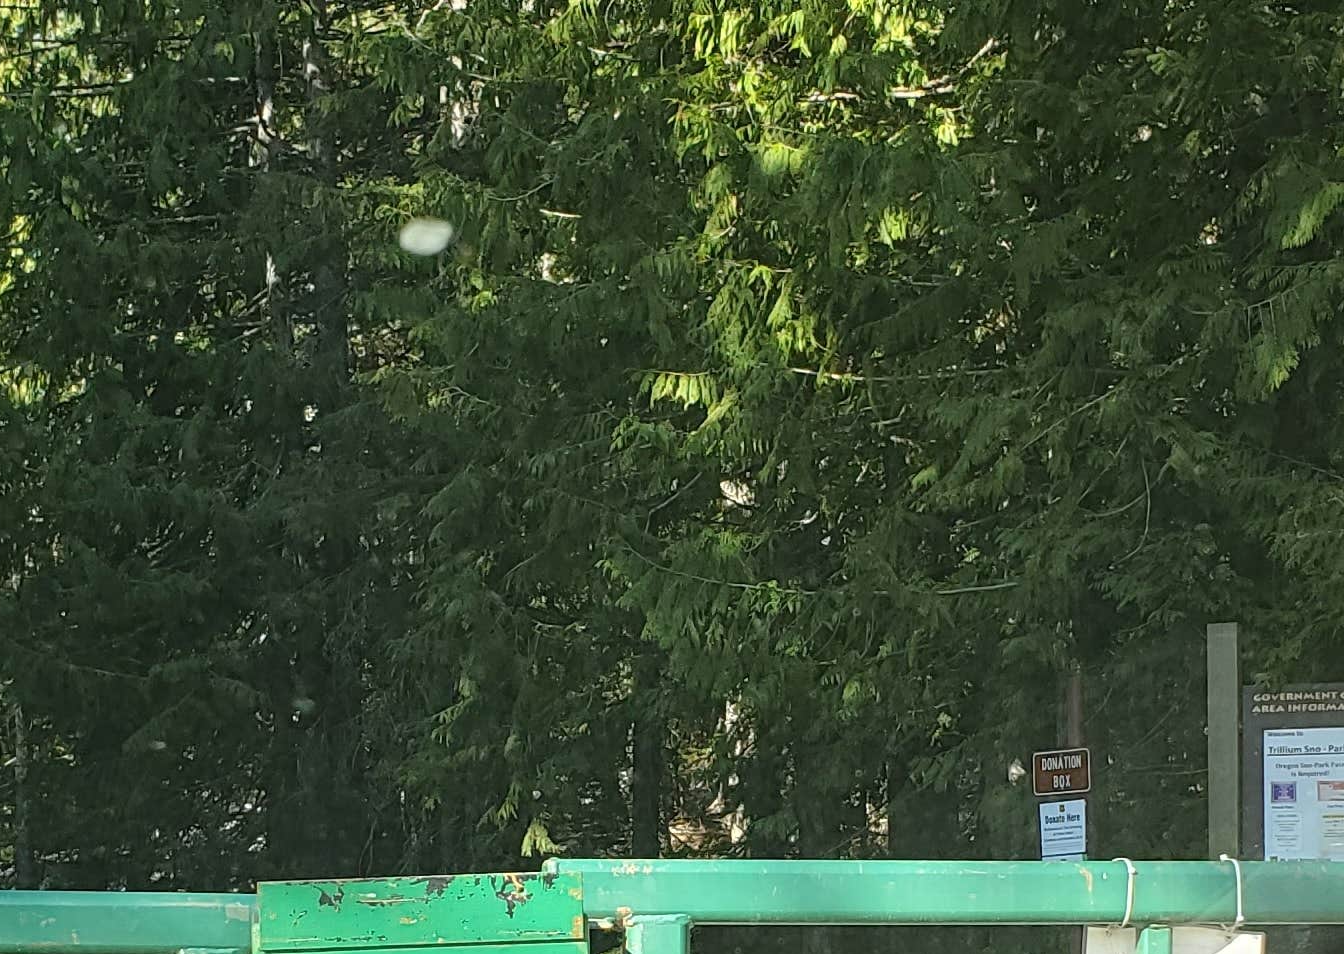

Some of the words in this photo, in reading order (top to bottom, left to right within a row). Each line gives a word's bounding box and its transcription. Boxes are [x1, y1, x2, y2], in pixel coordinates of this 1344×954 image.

[1253, 691, 1338, 702] GOVERNMENT
[1252, 703, 1285, 713] AREA
[1268, 745, 1302, 754] Trillium
[1304, 744, 1321, 753] Sno
[1041, 754, 1082, 771] DONATION
[1053, 774, 1071, 788] BOX
[1044, 814, 1066, 825] Donate
[1067, 813, 1081, 822] Here
